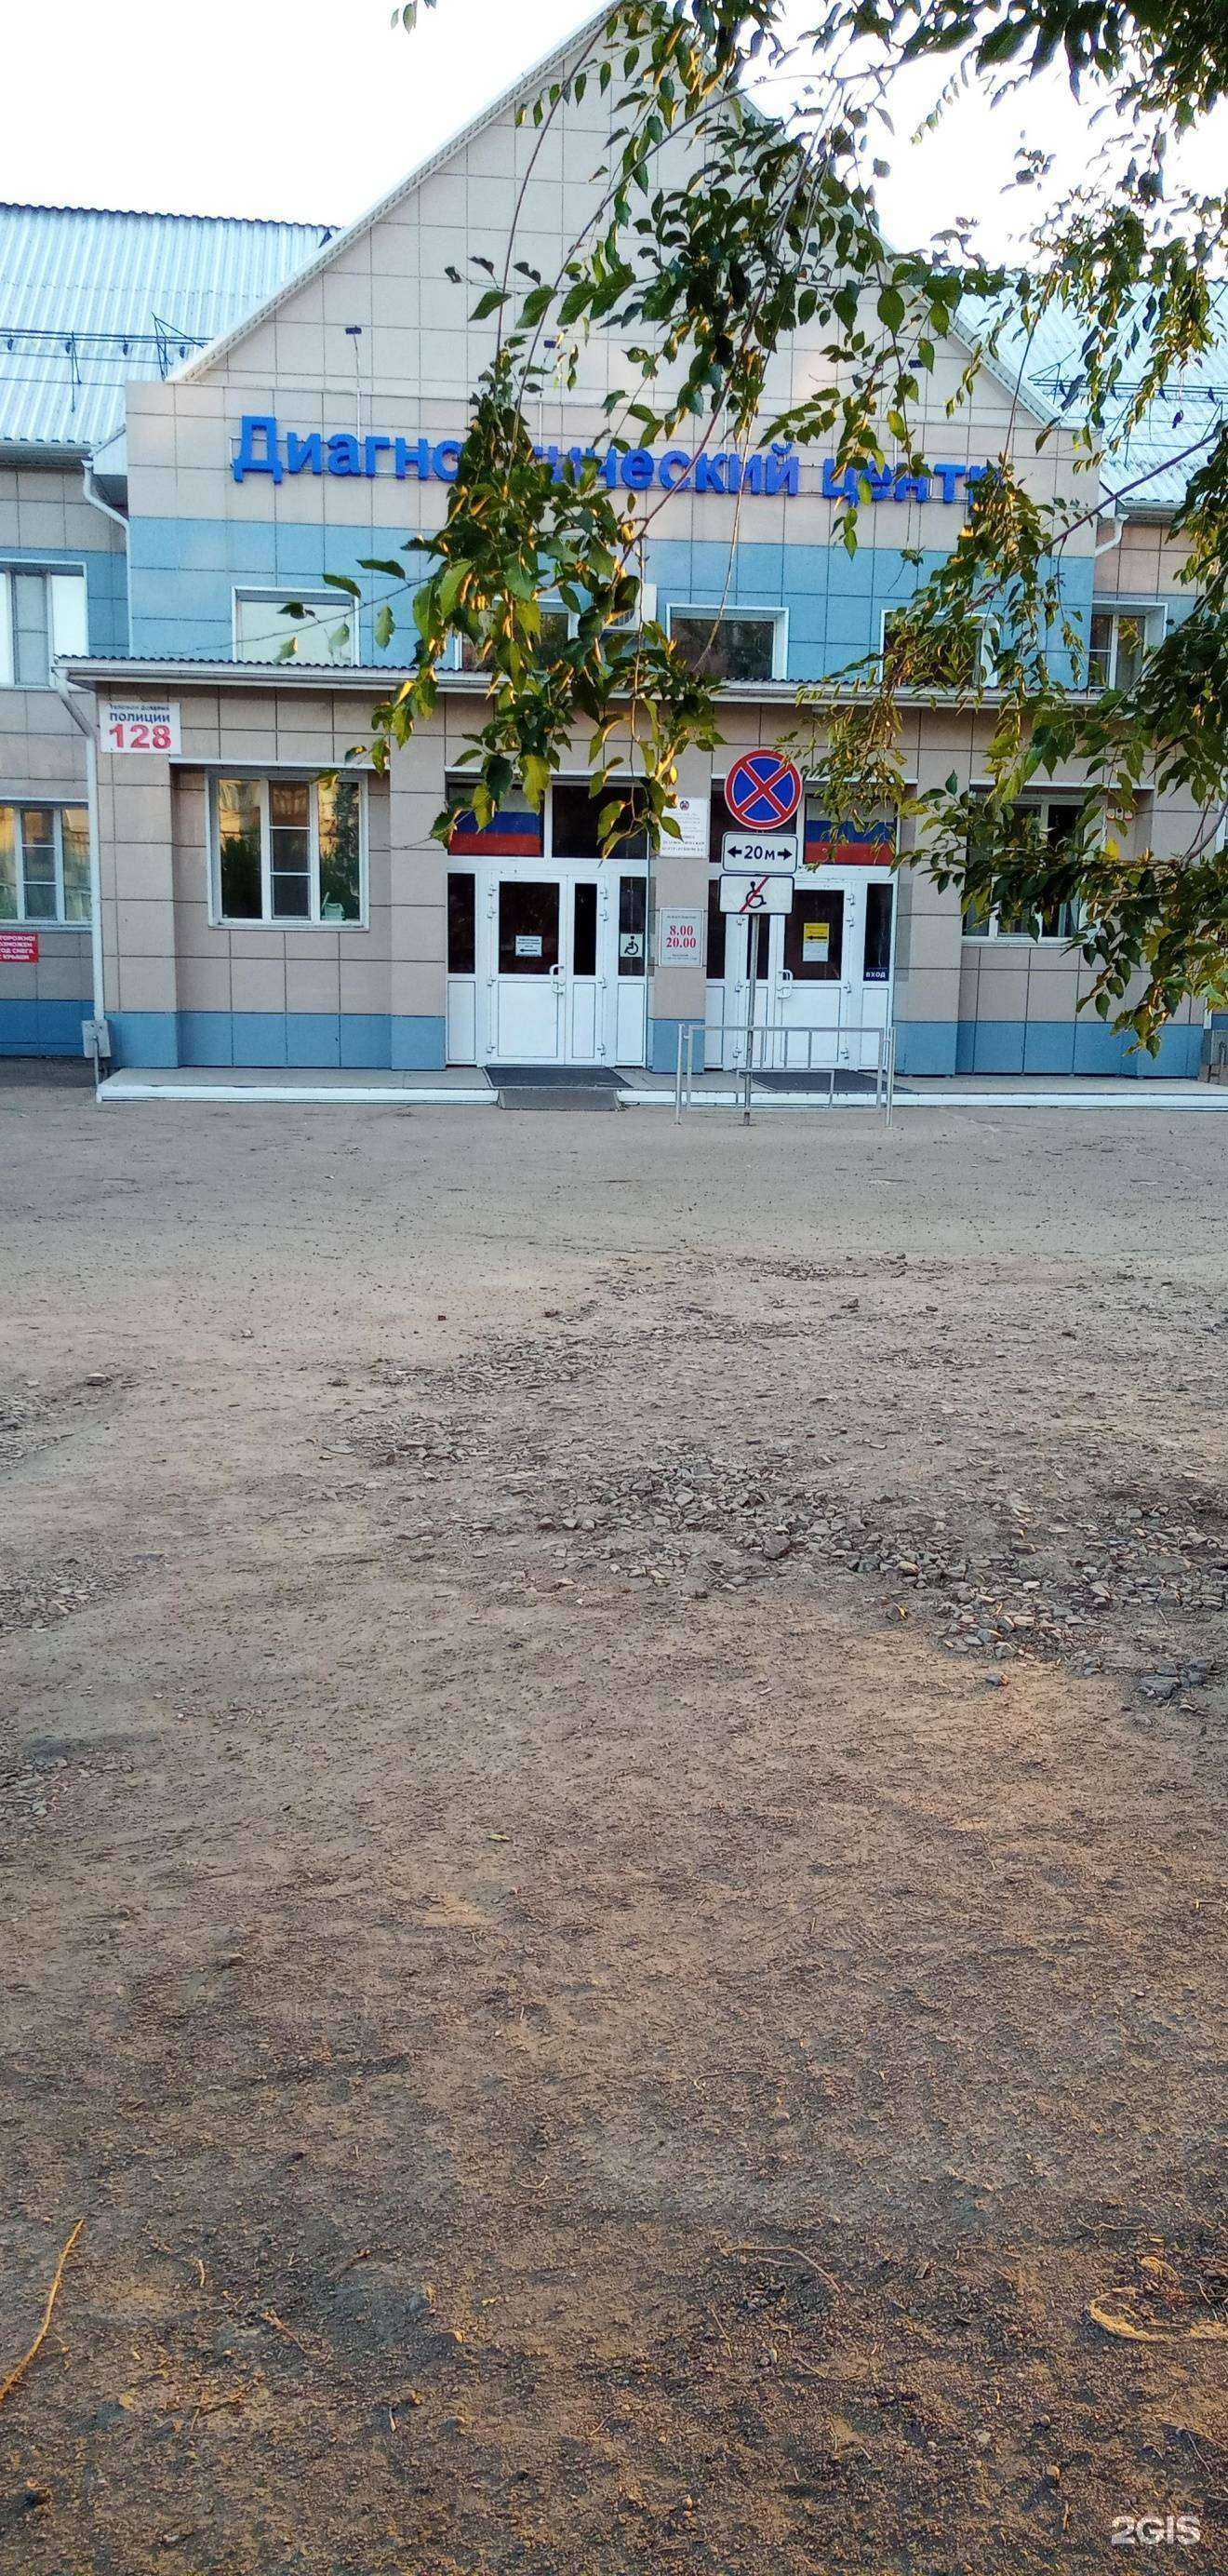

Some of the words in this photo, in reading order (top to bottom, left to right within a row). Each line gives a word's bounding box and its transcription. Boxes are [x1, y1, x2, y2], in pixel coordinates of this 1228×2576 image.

[110, 713, 169, 723] ПОЛИЦИИ
[109, 724, 171, 749] 128
[670, 925, 693, 935] 8.00
[666, 937, 696, 948] 20.00
